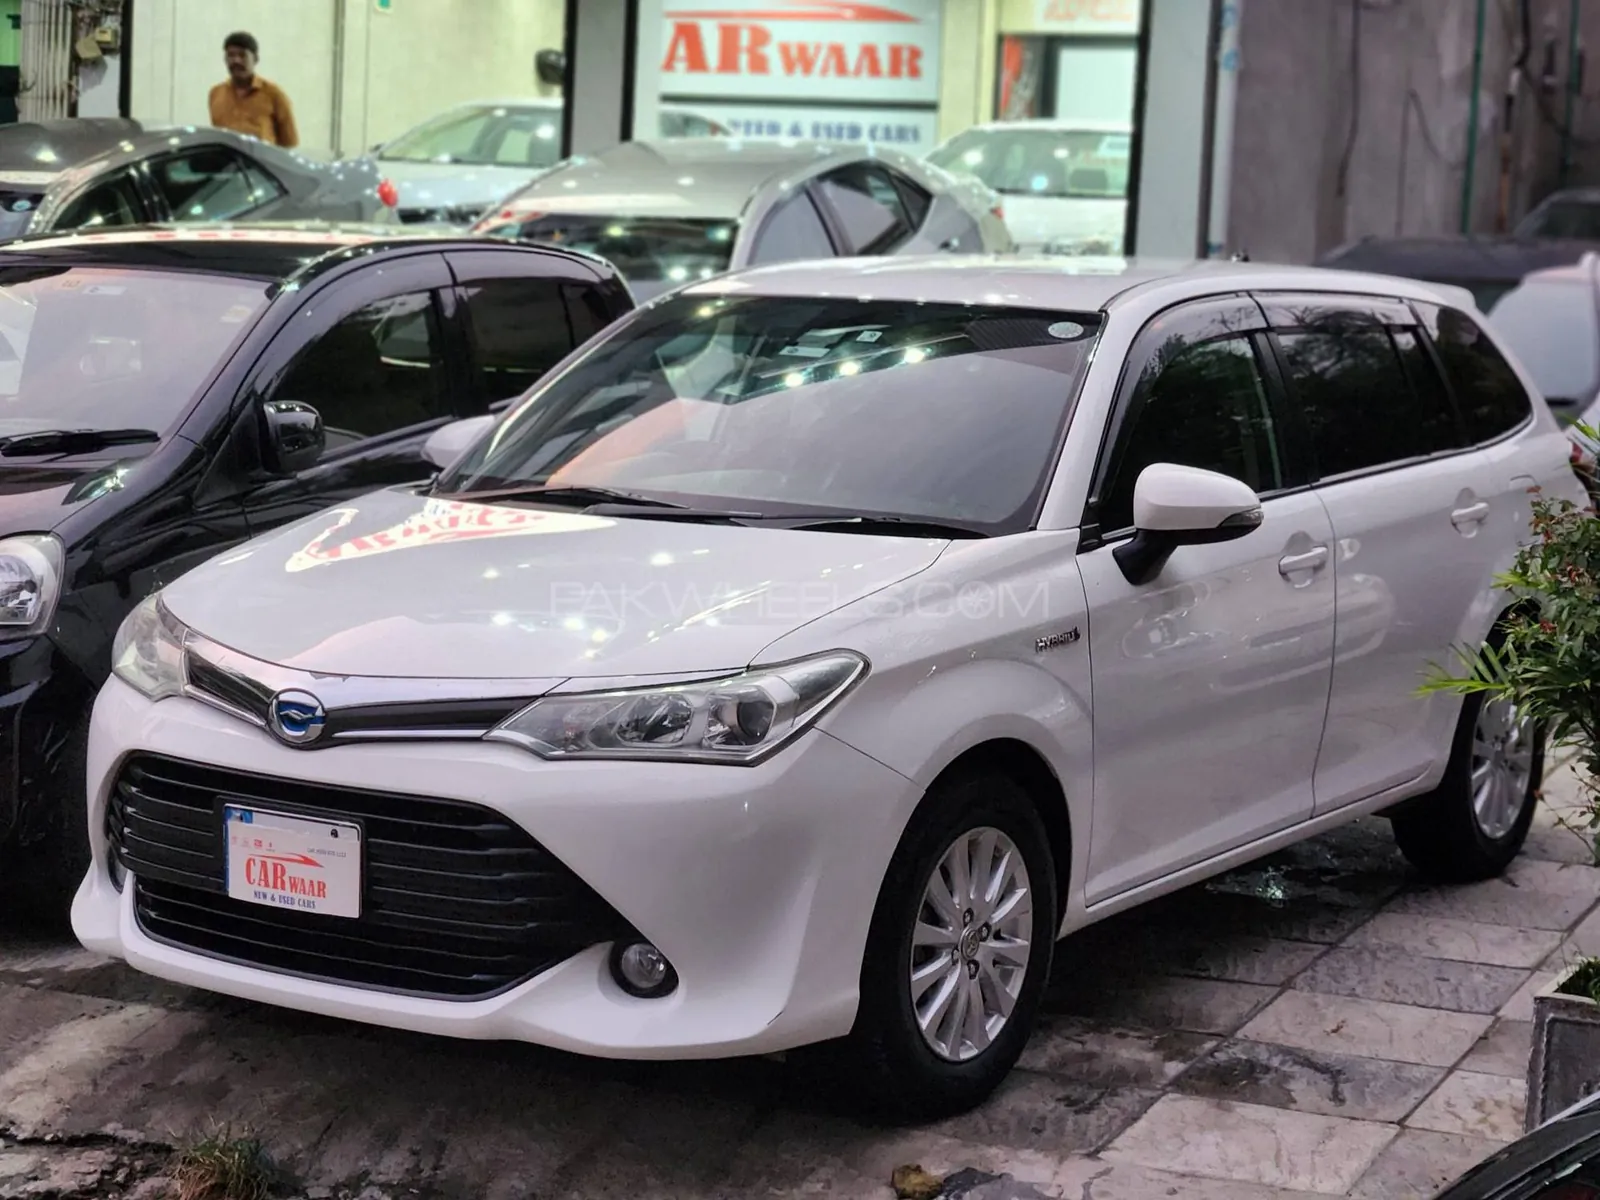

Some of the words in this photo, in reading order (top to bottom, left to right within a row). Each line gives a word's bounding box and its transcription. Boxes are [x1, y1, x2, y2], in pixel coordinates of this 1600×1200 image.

[253, 890, 268, 901] NEW
[278, 895, 296, 906] USED
[297, 898, 316, 910] CARS
